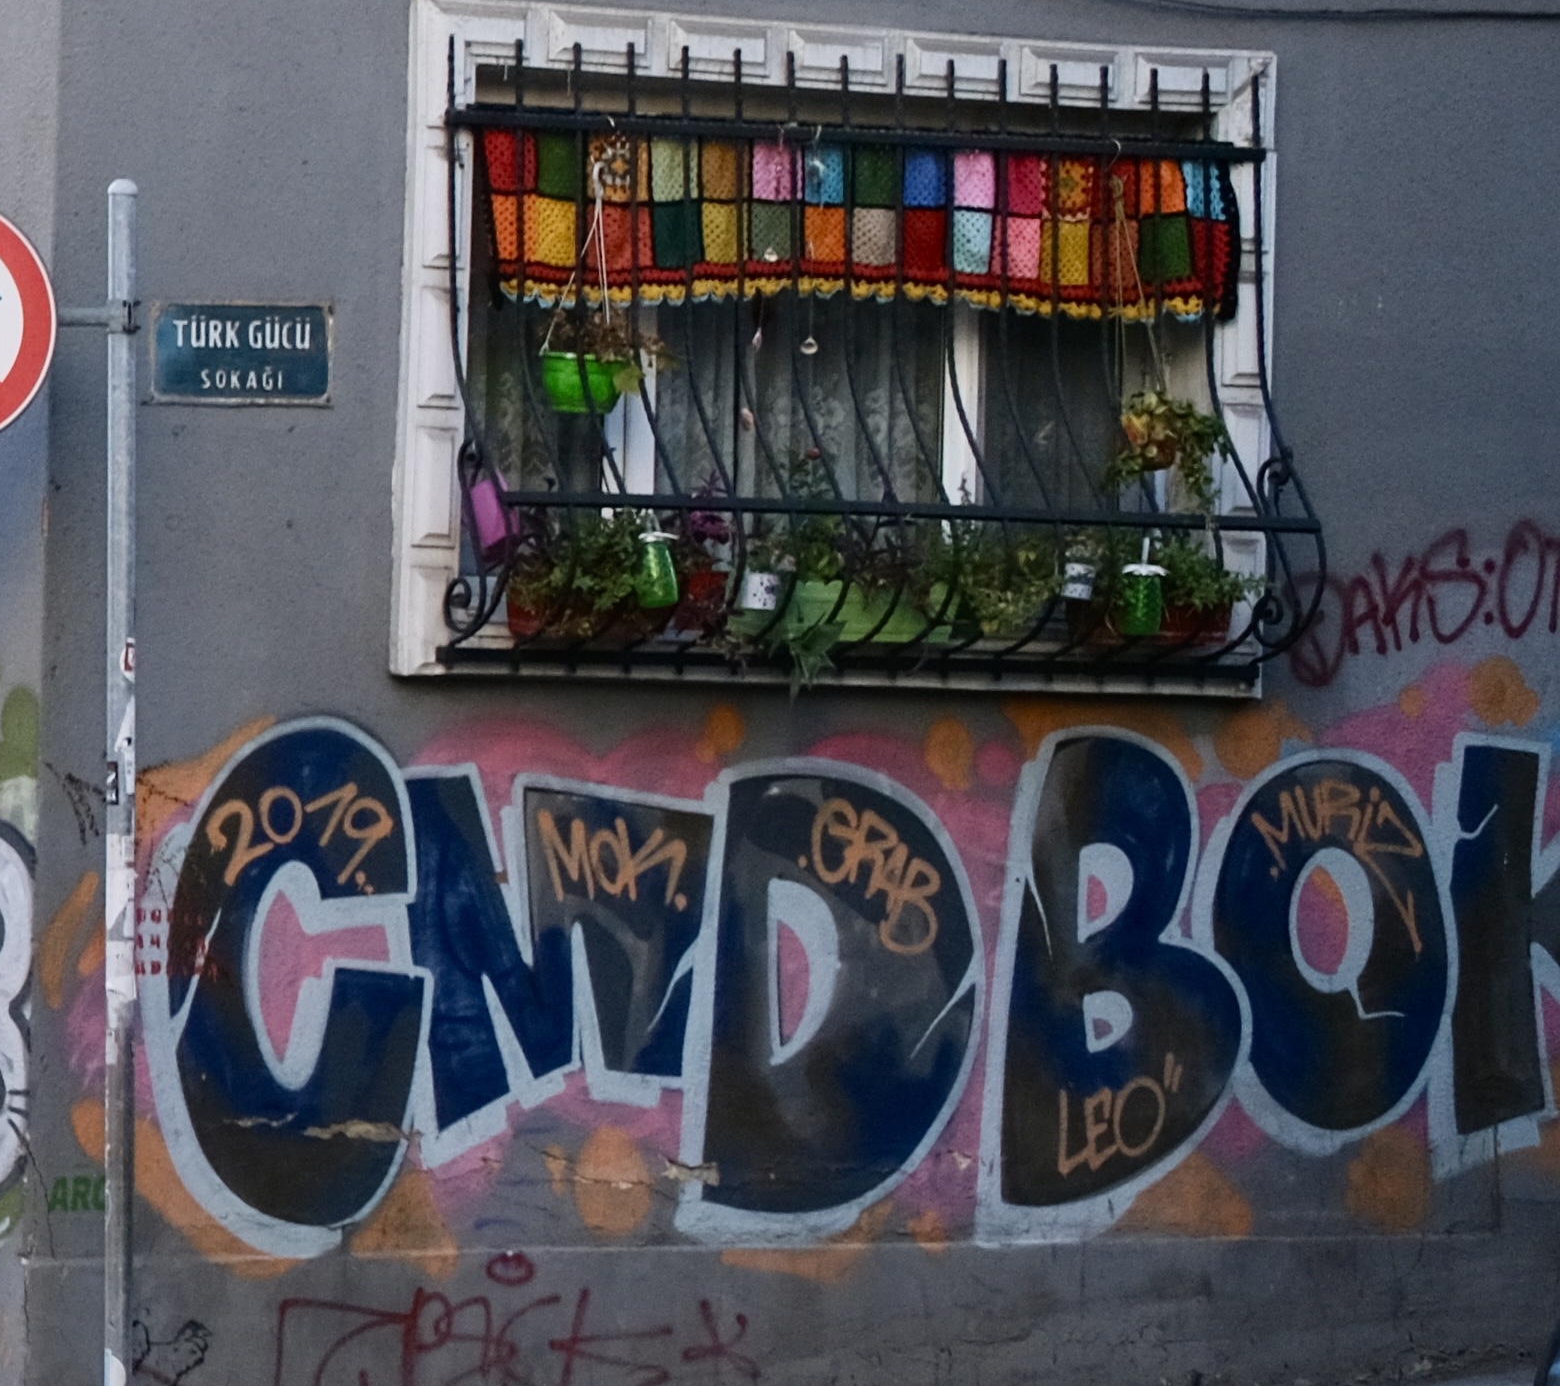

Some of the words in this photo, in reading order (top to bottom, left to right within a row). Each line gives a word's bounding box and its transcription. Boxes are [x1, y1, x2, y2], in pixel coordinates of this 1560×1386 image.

[173, 315, 239, 350] TÜRK
[248, 315, 311, 350] GÜCÜ
[201, 366, 284, 391] SOKAĞI
